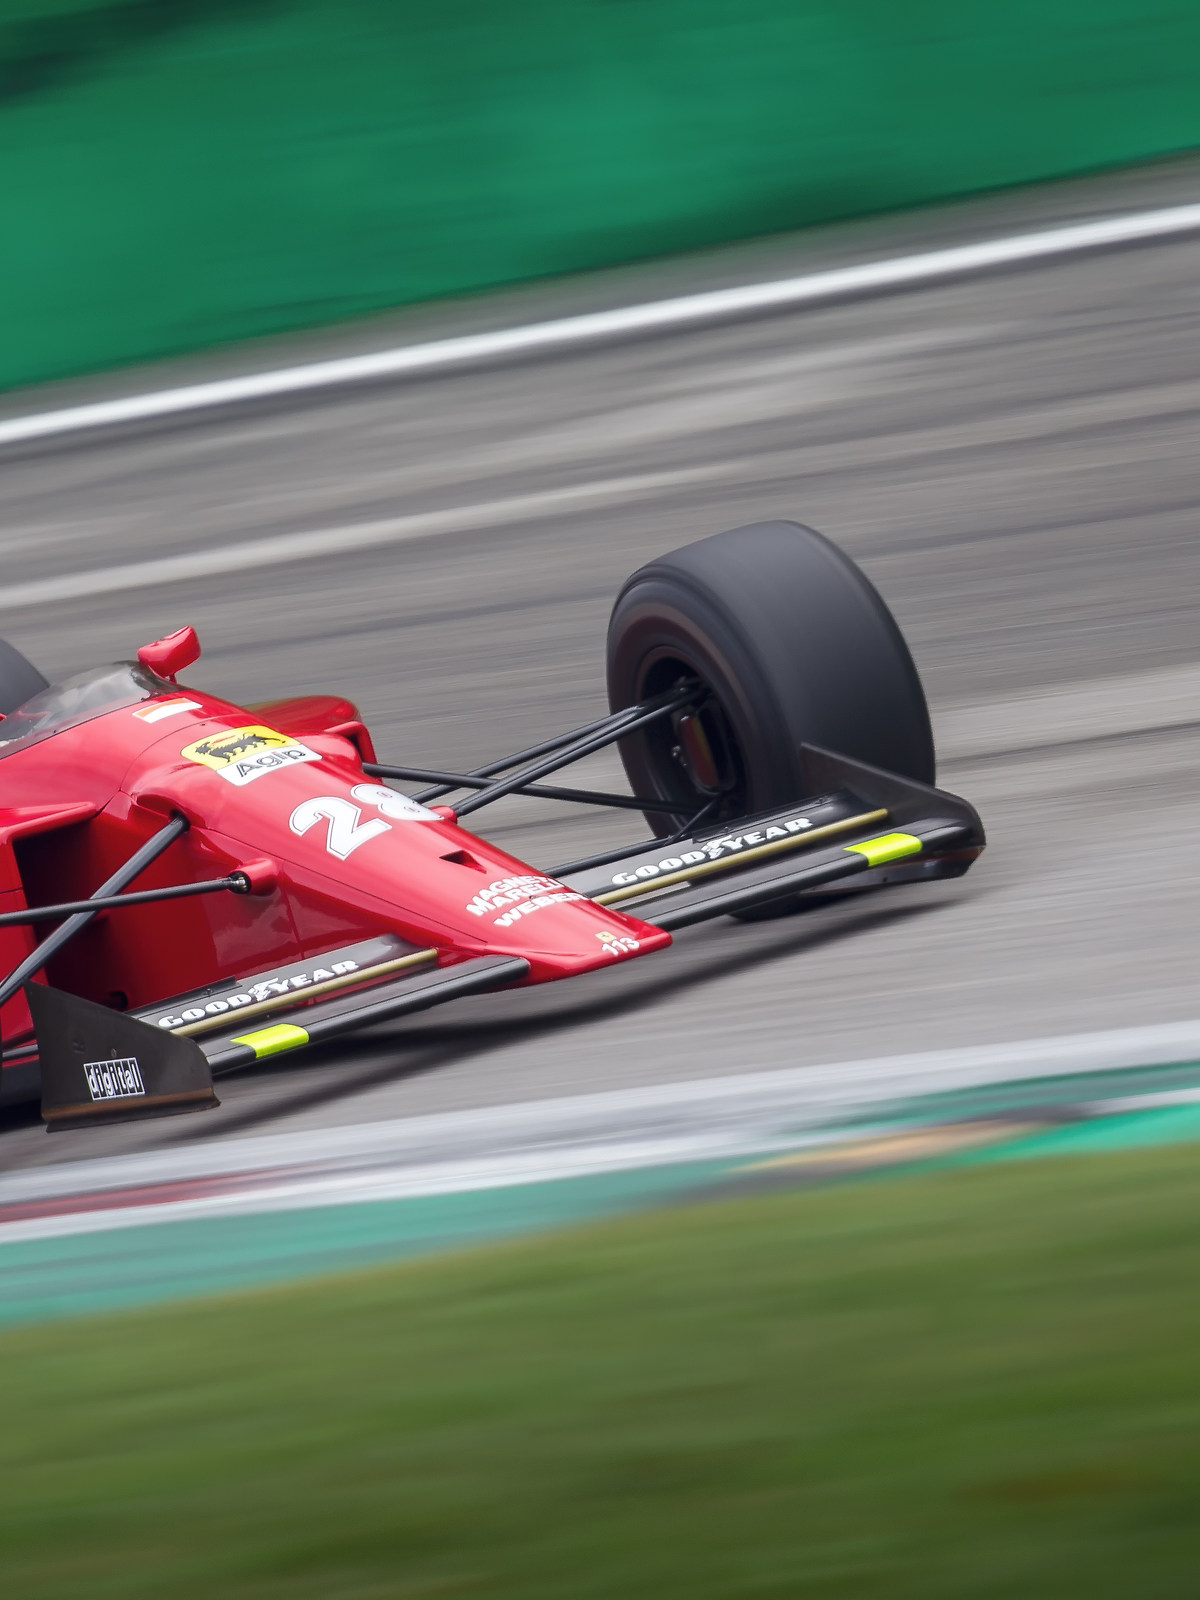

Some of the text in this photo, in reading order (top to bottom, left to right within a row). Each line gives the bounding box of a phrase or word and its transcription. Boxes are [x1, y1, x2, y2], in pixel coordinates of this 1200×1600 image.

[234, 748, 307, 778] Agip
[288, 783, 445, 861] 28
[493, 892, 590, 927] WEBER
[602, 937, 640, 956] 113
[87, 1061, 142, 1097] digital
